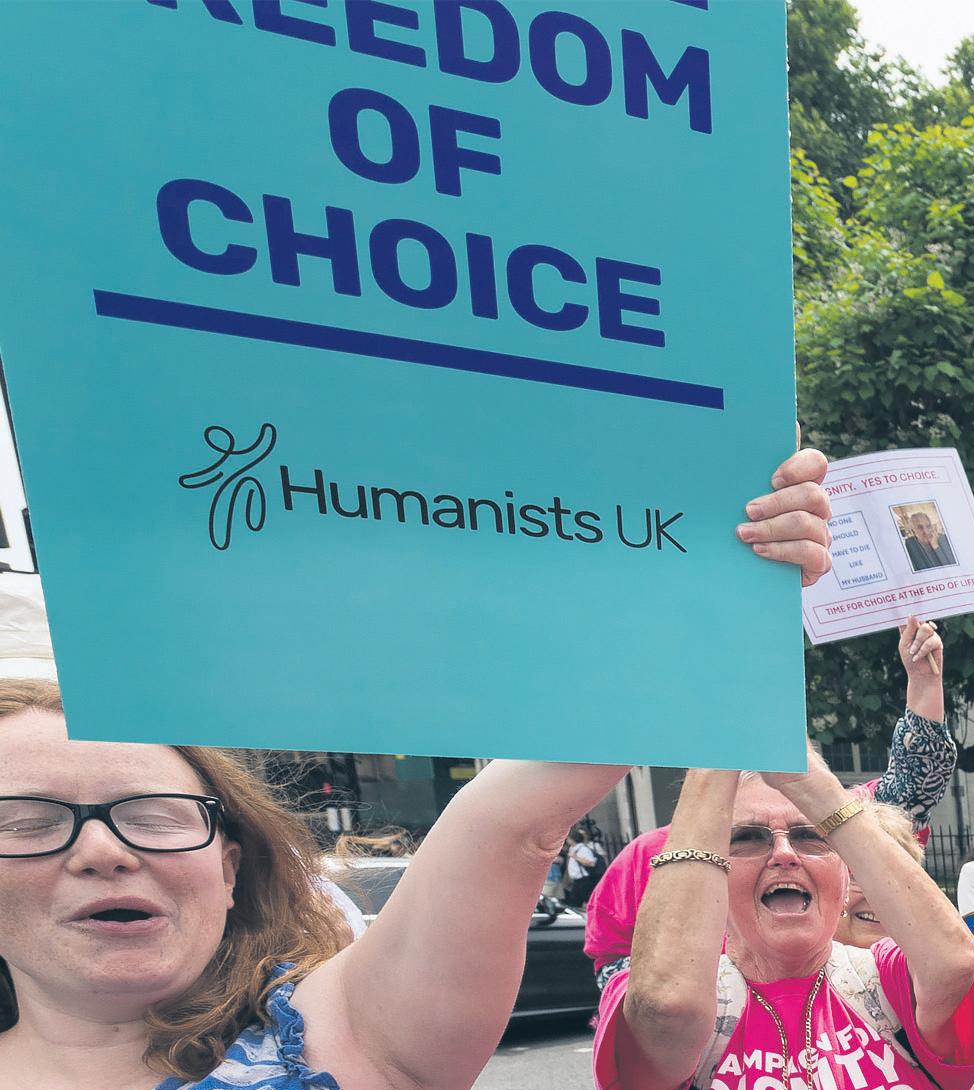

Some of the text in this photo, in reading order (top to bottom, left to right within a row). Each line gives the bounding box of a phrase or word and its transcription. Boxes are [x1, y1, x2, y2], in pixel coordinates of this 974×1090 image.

[328, 87, 502, 197] OF
[156, 178, 667, 348] CHOICE
[861, 476, 882, 489] YES
[883, 474, 898, 484] TO
[280, 465, 687, 553] Humanists UK
[832, 530, 859, 540] SHOULD
[832, 549, 849, 558] HAVE
[852, 572, 884, 584] HUSBAND
[825, 604, 846, 616] TIME
[847, 601, 864, 612] FOR
[864, 593, 897, 608] CHOICE
[898, 591, 909, 600] AT
[908, 587, 925, 598] THE
[926, 584, 946, 594] END
[947, 580, 960, 589] OF
